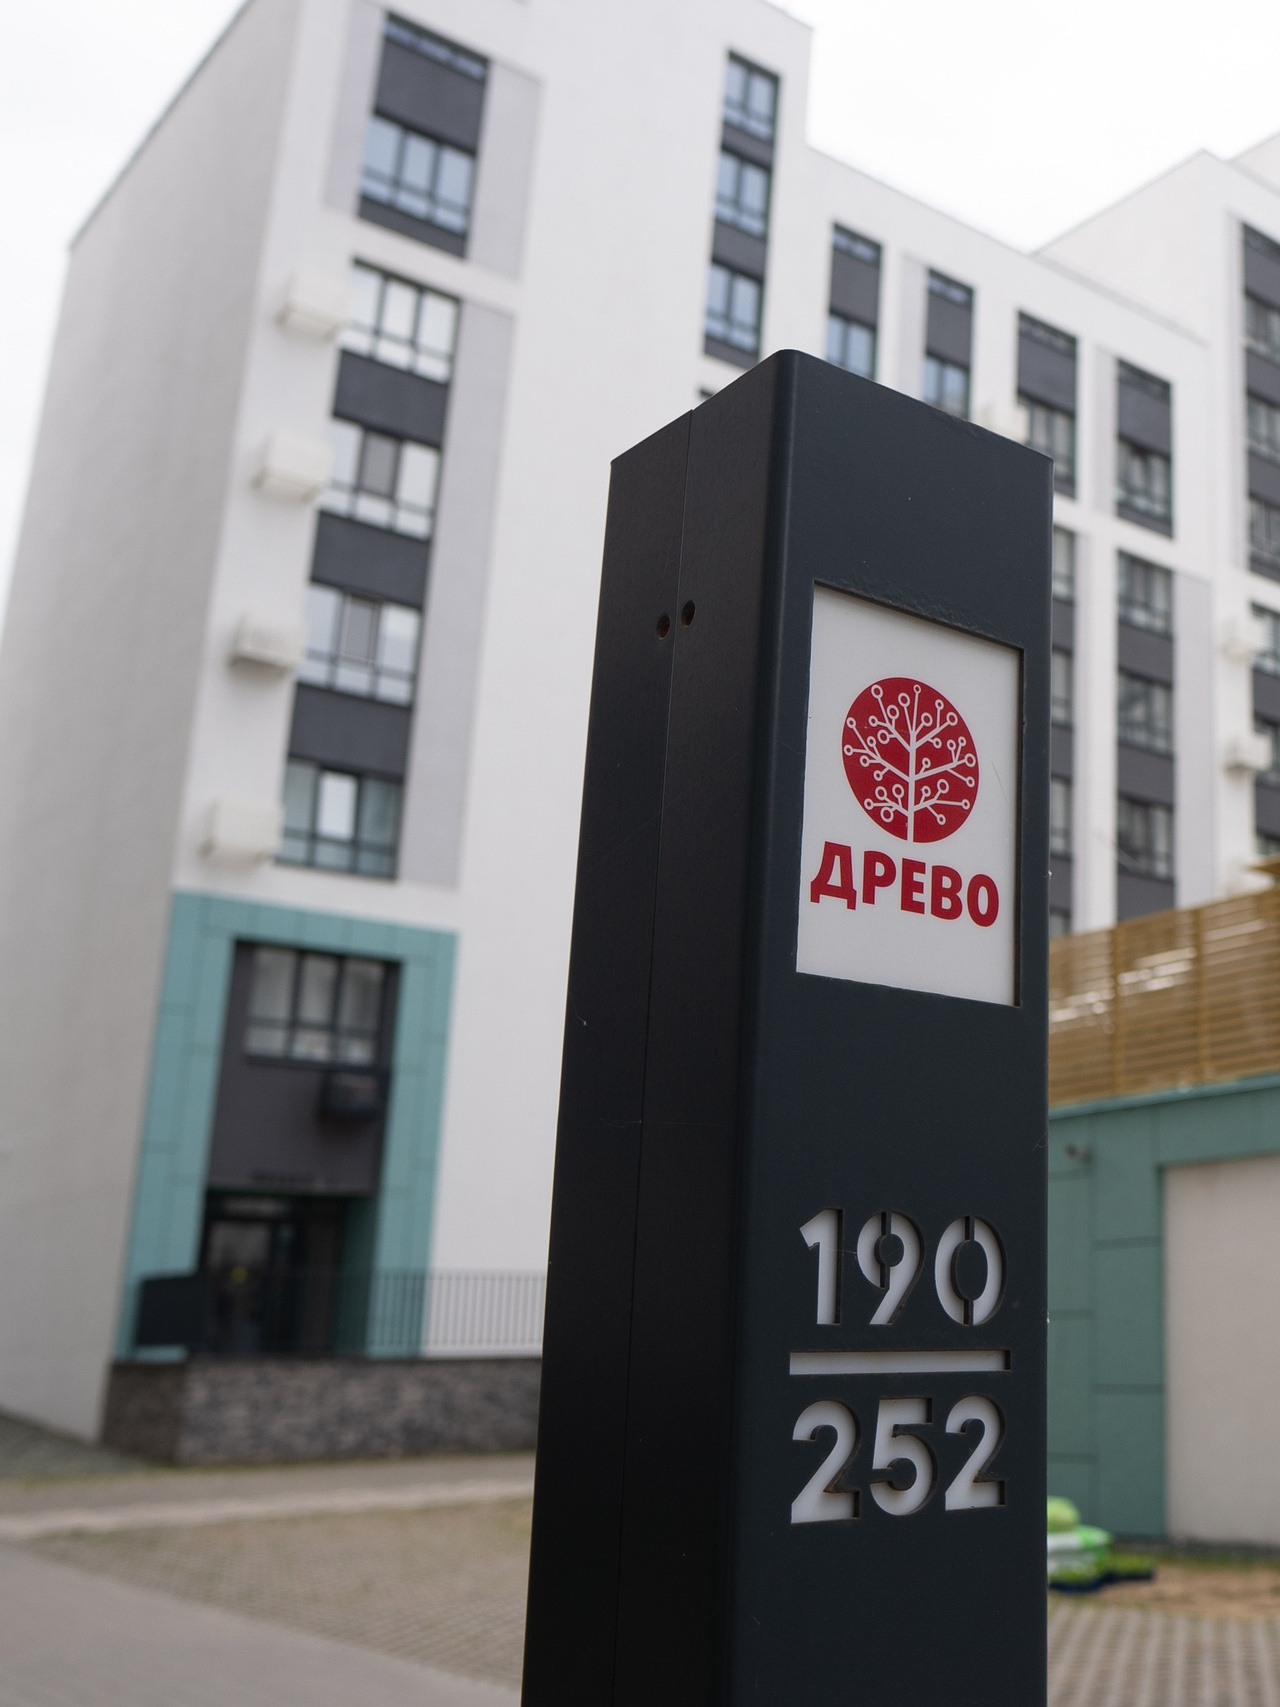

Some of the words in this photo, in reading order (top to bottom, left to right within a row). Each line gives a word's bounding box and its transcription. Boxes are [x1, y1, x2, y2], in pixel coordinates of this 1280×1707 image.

[810, 841, 999, 927] ДРЕВО
[800, 1207, 1007, 1326] 190
[791, 1396, 1006, 1524] 252
